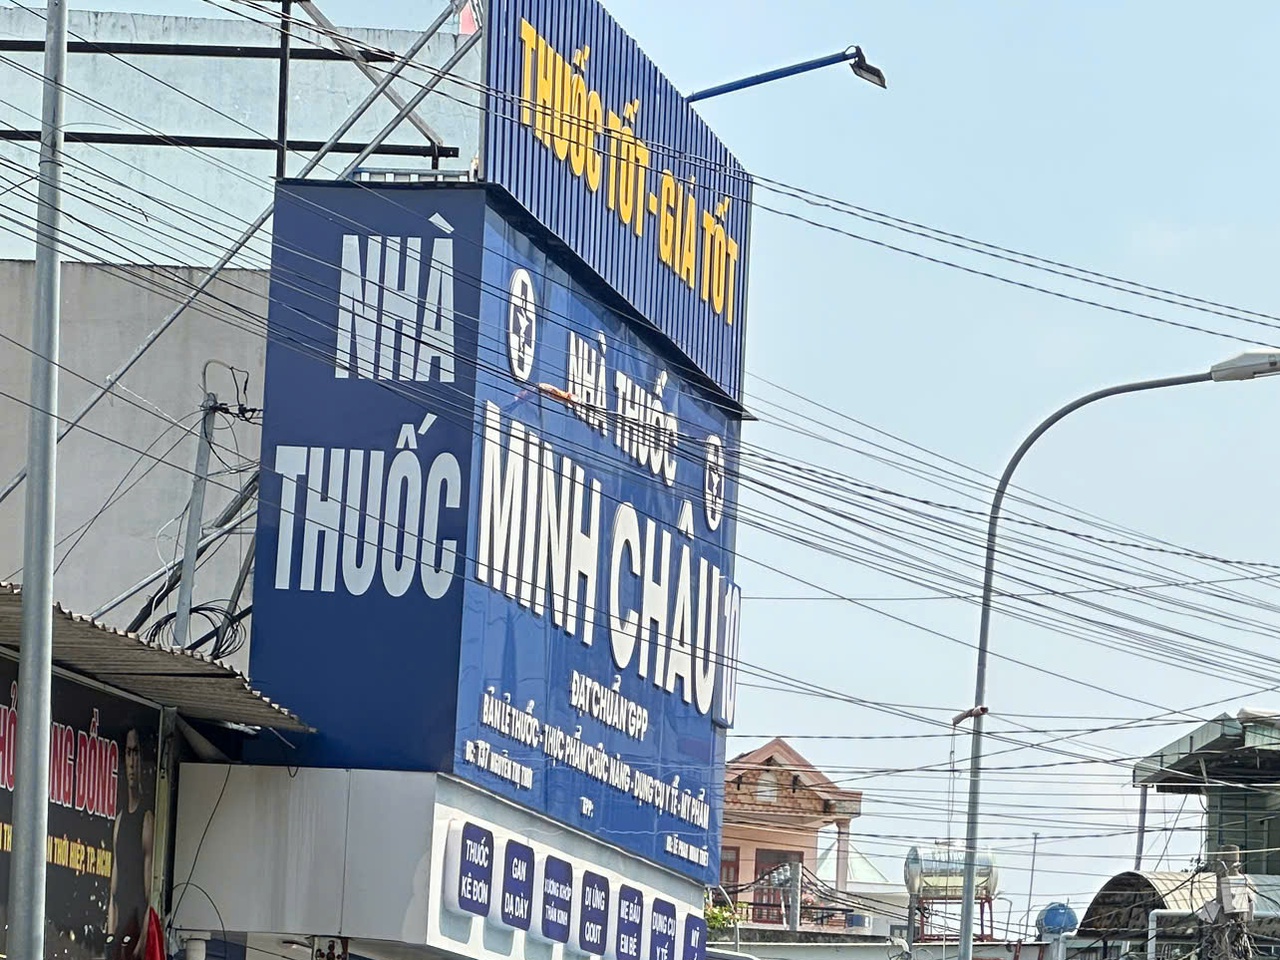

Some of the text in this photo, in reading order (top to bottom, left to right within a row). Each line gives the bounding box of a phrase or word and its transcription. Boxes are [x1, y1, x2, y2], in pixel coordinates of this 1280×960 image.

[520, 17, 602, 192] THUỐC
[607, 100, 650, 238] TỐT
[658, 169, 696, 289] GIÁ
[701, 196, 738, 325] TỐT
[334, 212, 456, 383] NHÀ
[568, 330, 678, 487] NHÀ THUỐC
[274, 414, 462, 599] THUỐC
[476, 399, 742, 728] MINH CHÂU 10
[511, 700, 540, 749] THUỐC
[544, 723, 565, 767] THỰC
[565, 725, 587, 772] PHẨM
[571, 670, 649, 741] ĐẠT CHUẨN GPP
[465, 835, 489, 868] THUỐC
[511, 858, 527, 882] GAN
[461, 875, 488, 906] KÊ ĐƠN
[504, 891, 529, 920] DẠ DÀY
